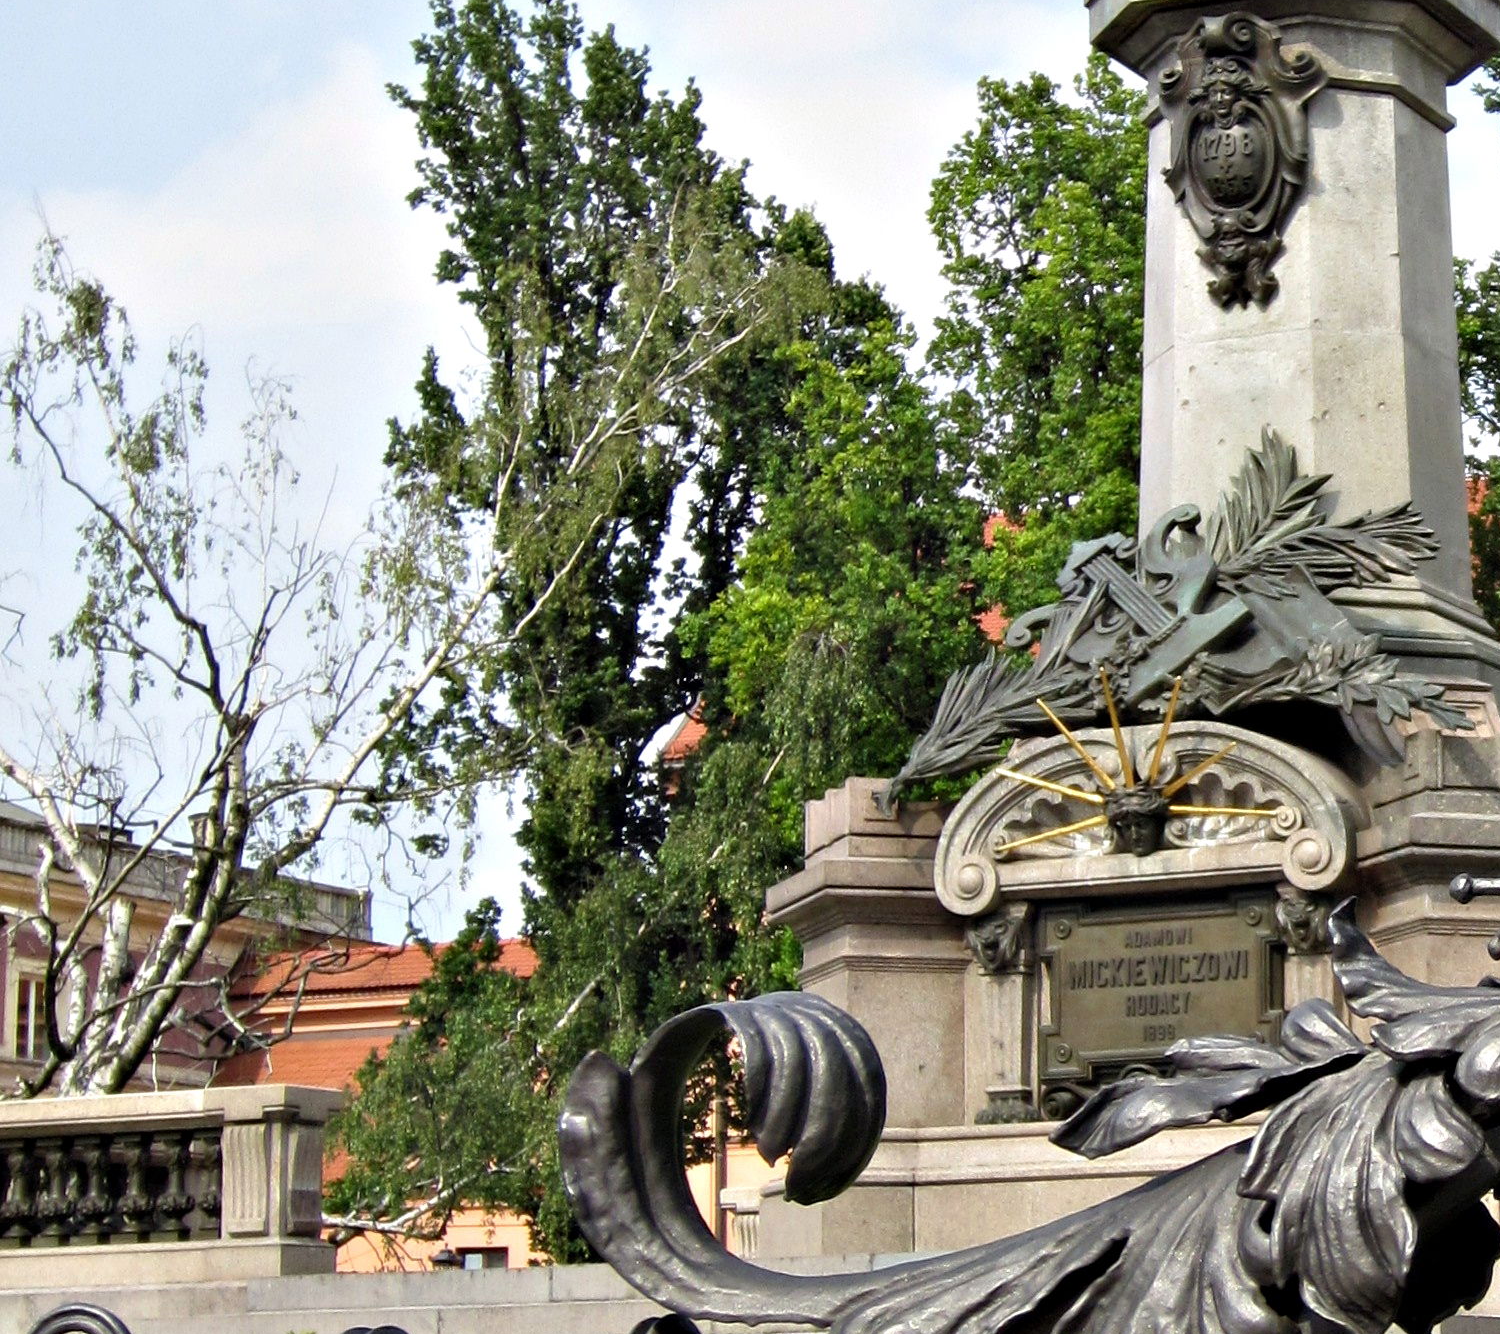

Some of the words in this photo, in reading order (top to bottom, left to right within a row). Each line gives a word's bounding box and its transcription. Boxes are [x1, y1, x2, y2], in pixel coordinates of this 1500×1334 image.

[1202, 132, 1255, 162] 1798
[1125, 928, 1192, 948] ADAMOWI
[1069, 951, 1249, 990] MICKIEWICZOWI
[1125, 992, 1191, 1017] RODACY
